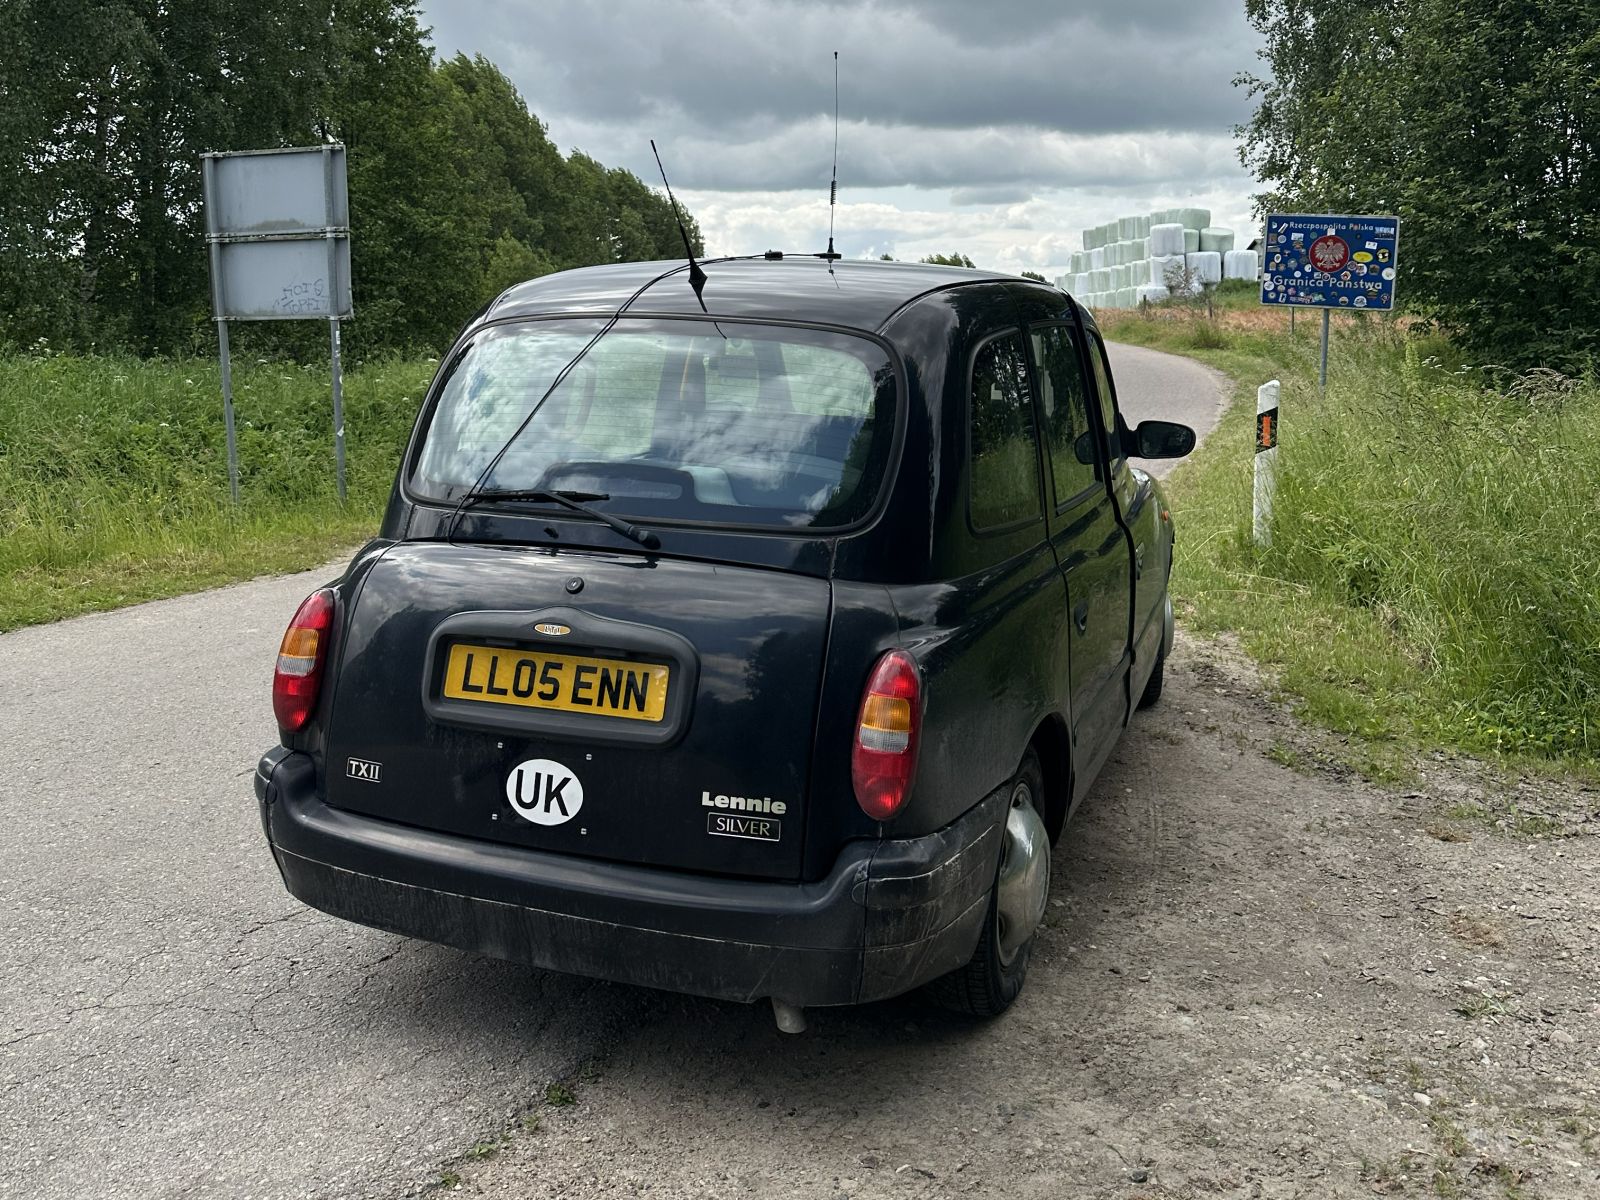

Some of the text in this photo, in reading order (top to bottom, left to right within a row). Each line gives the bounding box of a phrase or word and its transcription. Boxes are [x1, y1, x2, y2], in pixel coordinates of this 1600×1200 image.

[1289, 221, 1347, 231] Rzeczpospolita
[1273, 275, 1324, 287] Granica
[462, 653, 650, 712] LL05 ENN
[515, 769, 572, 817] UK
[701, 791, 787, 814] Lennie
[716, 817, 770, 837] SILVER
